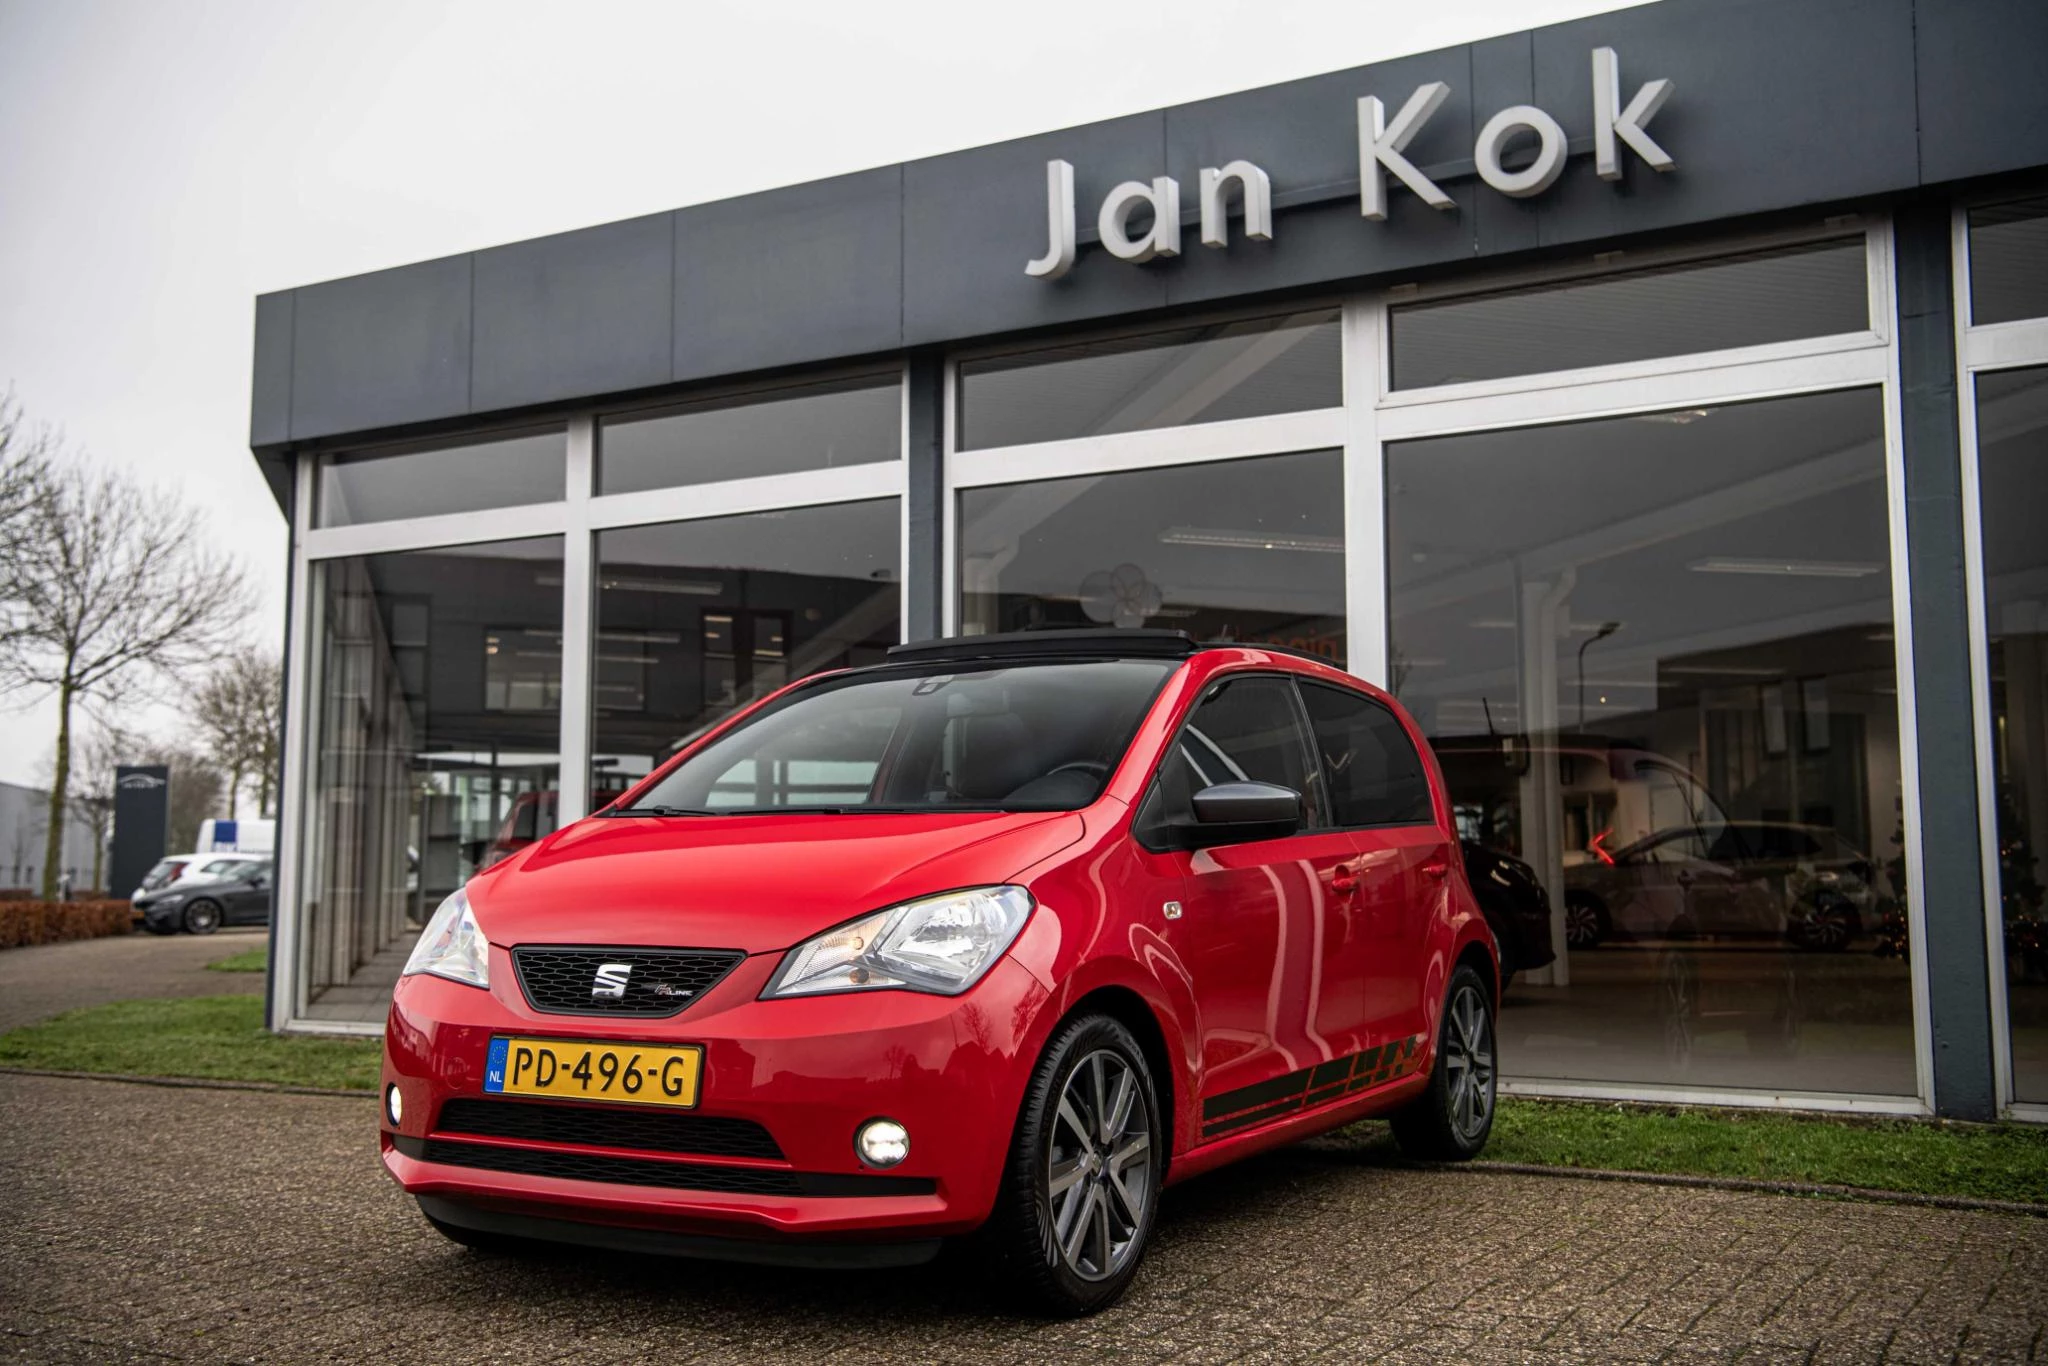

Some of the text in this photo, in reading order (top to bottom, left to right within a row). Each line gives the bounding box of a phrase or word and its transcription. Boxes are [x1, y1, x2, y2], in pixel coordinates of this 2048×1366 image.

[1025, 47, 1677, 280] Jan Kok
[489, 1070, 502, 1083] NL
[513, 1047, 684, 1097] PD-496-G
